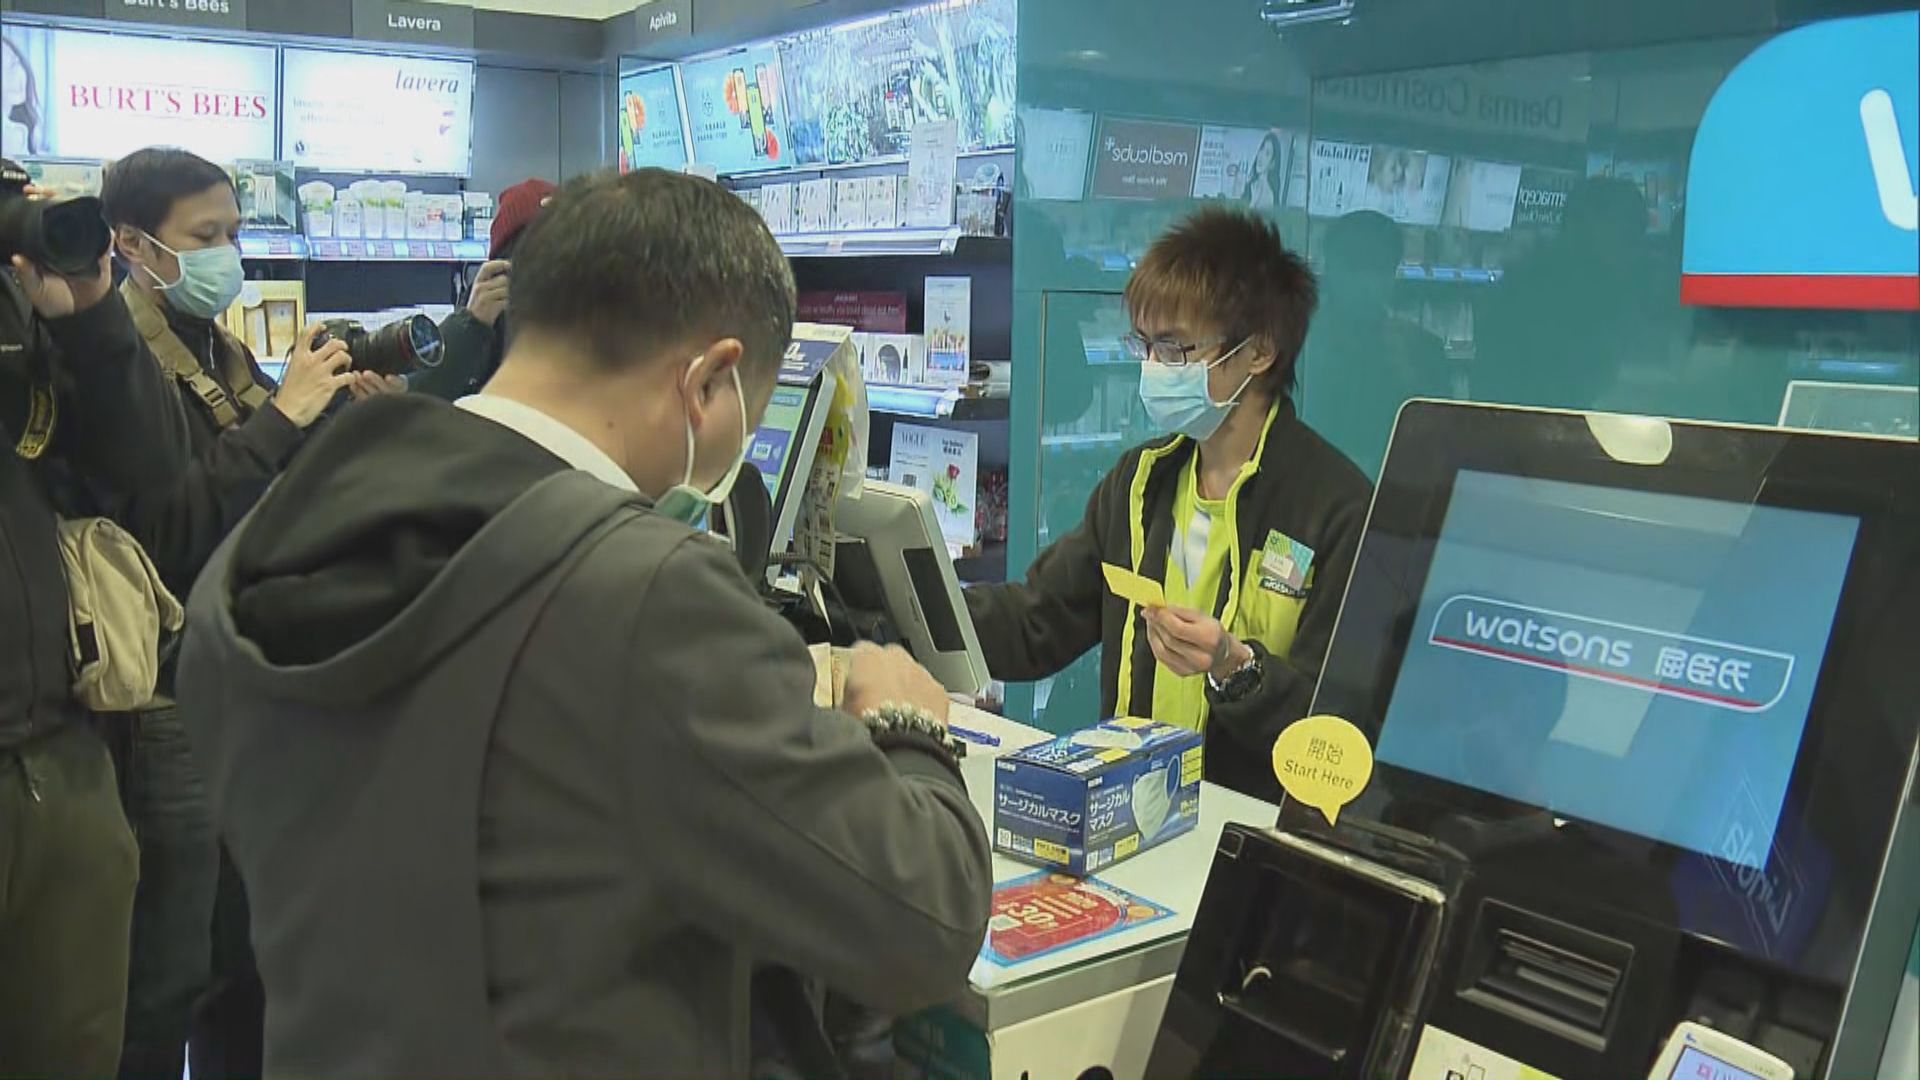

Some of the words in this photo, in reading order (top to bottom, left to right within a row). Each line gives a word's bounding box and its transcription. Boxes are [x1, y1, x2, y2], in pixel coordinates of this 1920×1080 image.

[388, 13, 441, 31] Lavera
[395, 69, 459, 93] lavera
[70, 84, 181, 113] BURT'S
[194, 92, 267, 119] BEES
[1466, 610, 1633, 667] watsons
[1655, 647, 1752, 692] 屈臣氏
[1306, 737, 1344, 765] 開始
[1284, 759, 1318, 780] Start
[1321, 769, 1354, 789] Here
[999, 793, 1081, 825] サージカルマスク
[1090, 790, 1131, 817] サージカル
[1089, 810, 1114, 832] マスク
